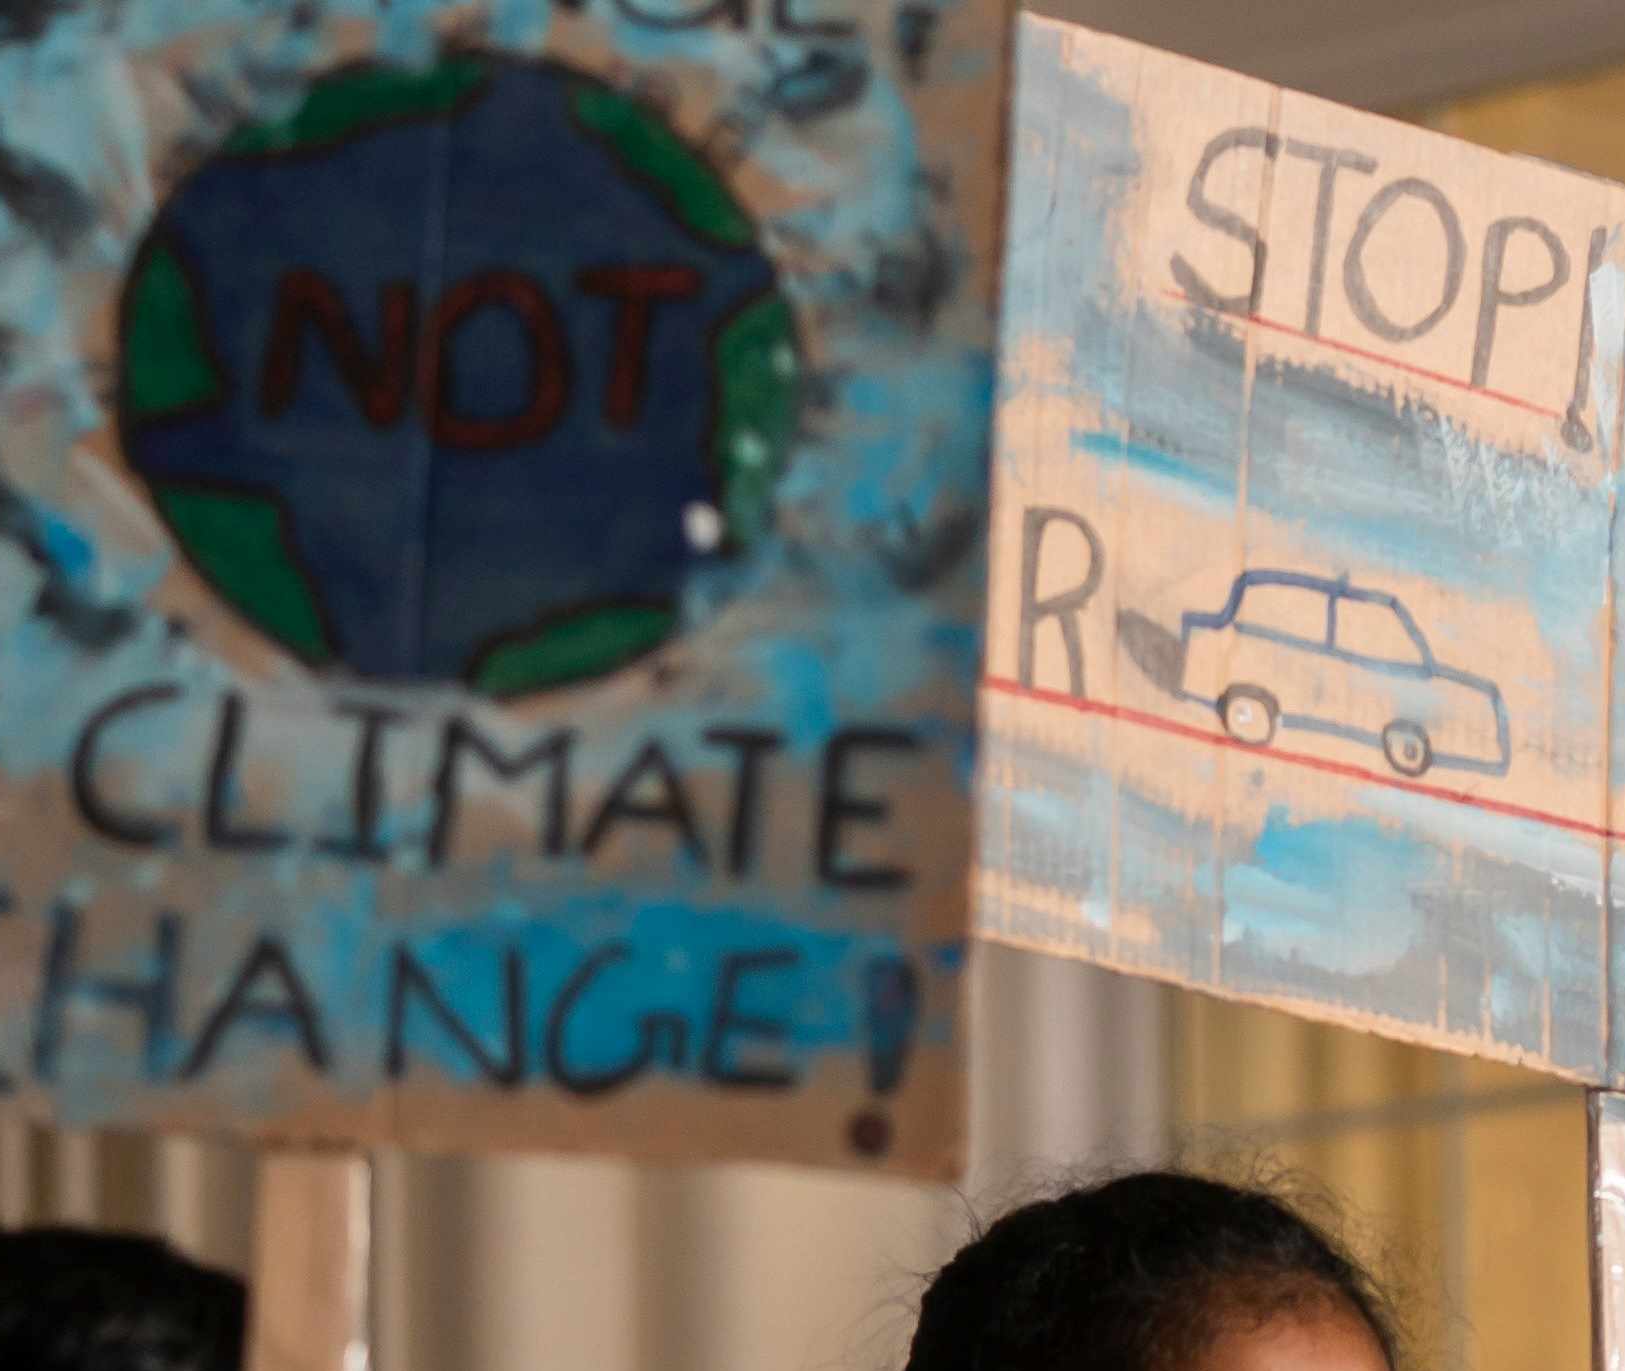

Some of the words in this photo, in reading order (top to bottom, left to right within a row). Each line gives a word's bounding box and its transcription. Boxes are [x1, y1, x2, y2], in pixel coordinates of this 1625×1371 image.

[257, 264, 706, 452] NOT
[1169, 126, 1608, 452] STOP!
[67, 682, 928, 893] CLIMATE
